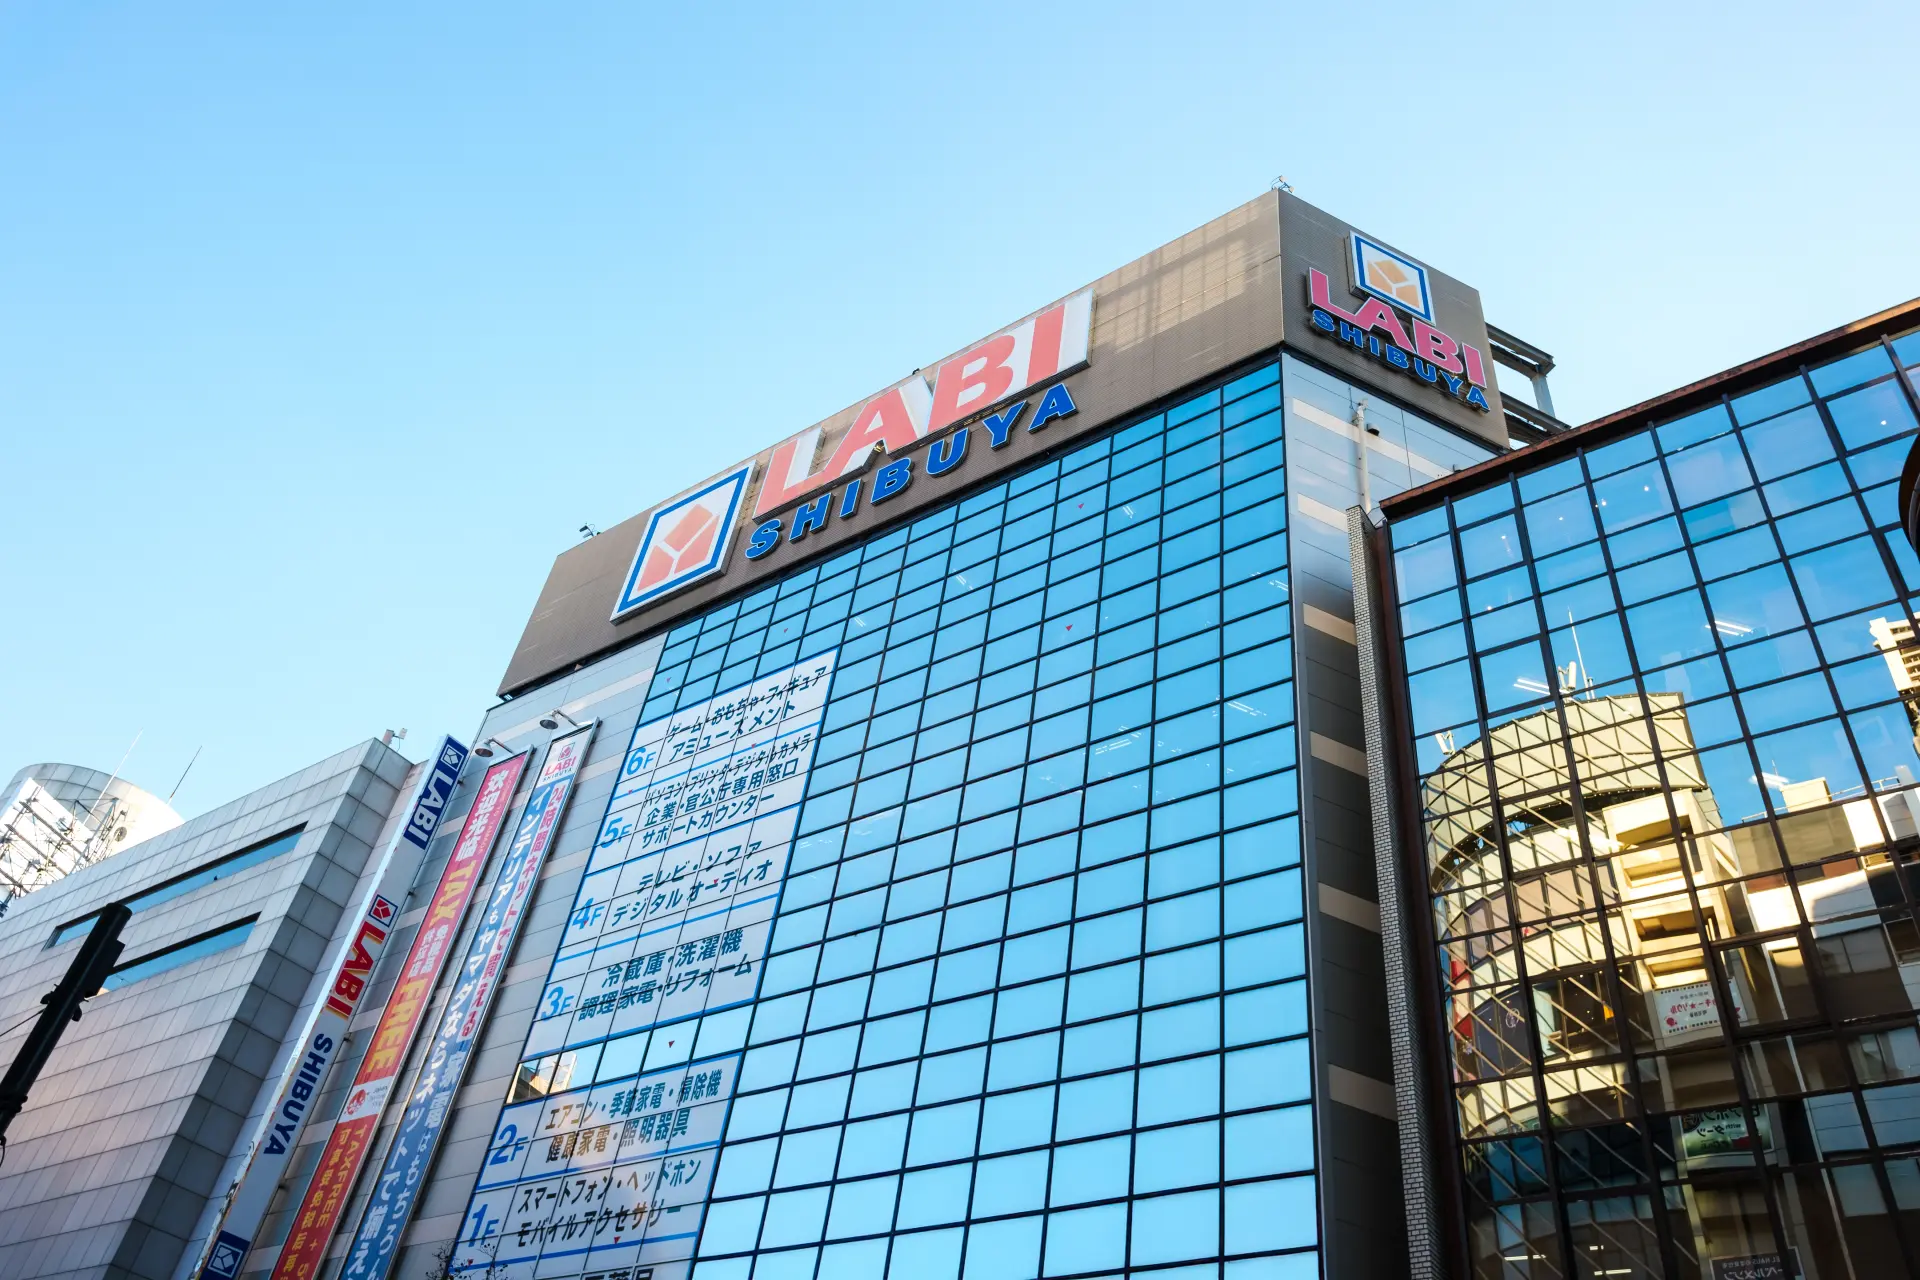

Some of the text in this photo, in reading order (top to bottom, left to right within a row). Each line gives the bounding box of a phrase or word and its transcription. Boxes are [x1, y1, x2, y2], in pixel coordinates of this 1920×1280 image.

[1309, 267, 1487, 389] LABI
[1312, 308, 1490, 412] SHIBUYA
[755, 302, 1066, 518] LABI
[745, 382, 1078, 561] SHIBUYA
[626, 747, 656, 777] 6F
[669, 701, 796, 762] アミューズメント
[545, 755, 576, 777] LABI
[644, 758, 799, 827] 企業・官公庁専用窓口
[407, 768, 454, 843] LABI
[600, 817, 632, 849] 5F
[643, 792, 775, 849] サポートカウンター
[427, 860, 477, 927] TAX
[612, 859, 773, 927] デジタルオーディオ
[637, 841, 762, 894] テレビ・ソファ
[572, 898, 605, 930] 4F
[326, 921, 387, 1019] LABI
[578, 953, 752, 1022] 調理家電・リフォーム
[601, 928, 744, 988] 冷蔵庫・洗濯機
[347, 786, 551, 1280] インテリアもヤマダならネットで揃え
[367, 977, 429, 1073] FREE
[542, 986, 574, 1022] 3F
[263, 1033, 333, 1155] SHIBUYA
[545, 1068, 723, 1130] エアコン・季節家電・掃除機
[489, 1124, 528, 1166] 2F
[546, 1108, 692, 1163] 健康家電・照明器具
[518, 1159, 702, 1214] スマートフォン・ヘッドホン
[468, 1203, 499, 1248] 1F
[518, 1199, 682, 1248] モバイルアクセサリー
